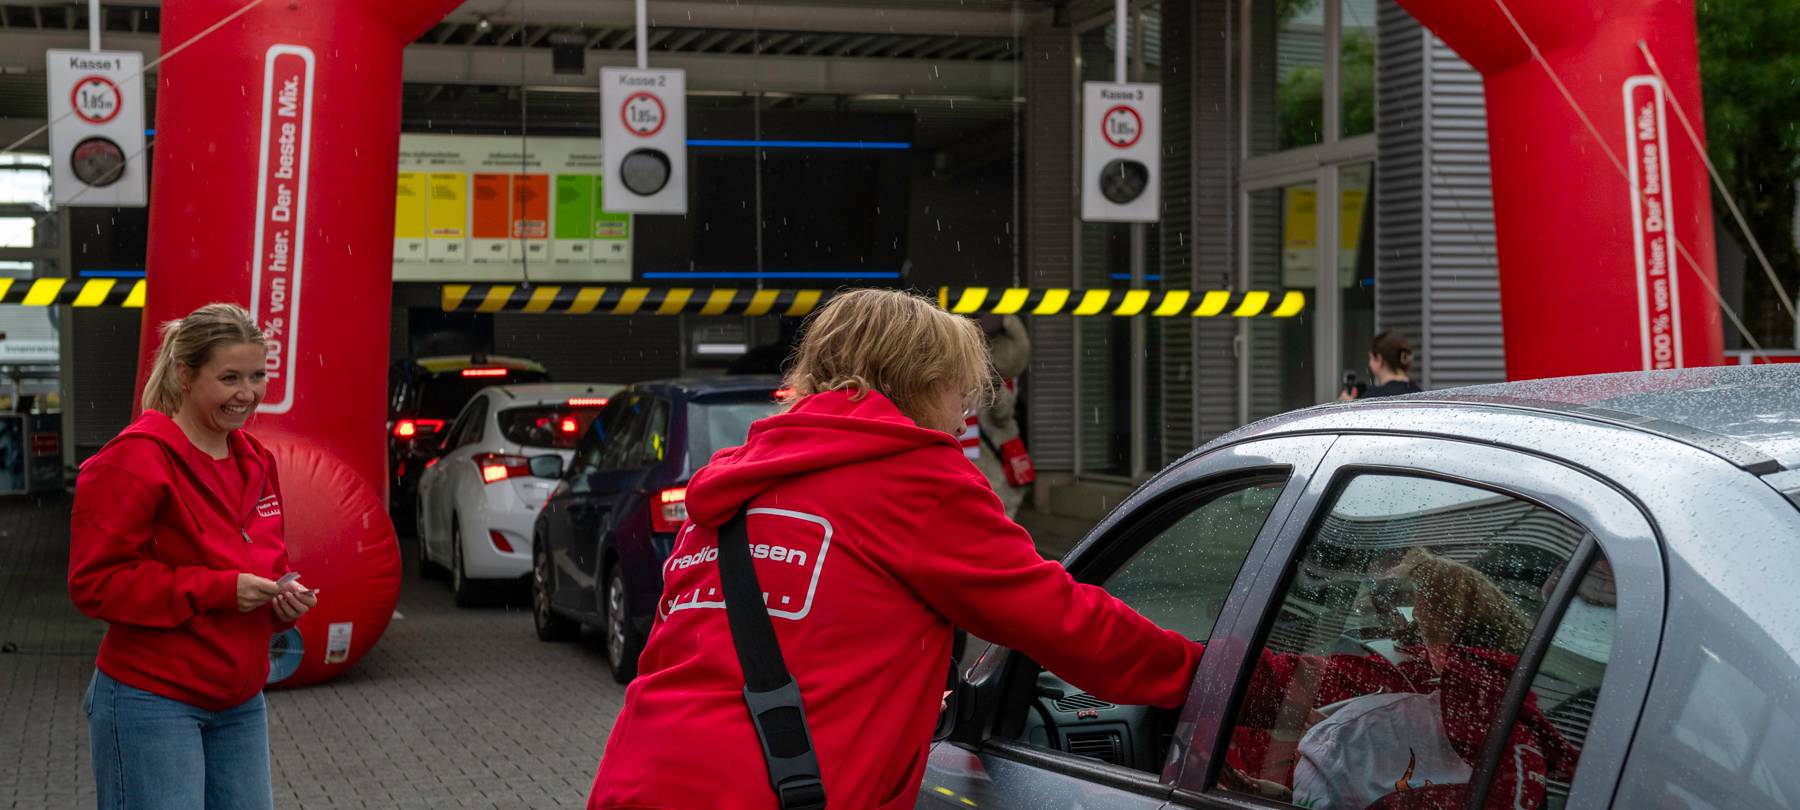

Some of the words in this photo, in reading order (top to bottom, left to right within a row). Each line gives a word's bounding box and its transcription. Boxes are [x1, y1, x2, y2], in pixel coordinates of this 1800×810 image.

[70, 56, 112, 70] Kasse
[115, 58, 121, 71] 1
[619, 75, 656, 87] Kasse
[658, 75, 667, 87] 2
[277, 74, 300, 118] Mix.
[1101, 88, 1134, 100] Kasse
[1136, 89, 1144, 101] 3
[1638, 101, 1656, 140] Mix.
[274, 122, 296, 180] beste
[1643, 142, 1660, 195] beste
[271, 183, 292, 223] Der
[1645, 197, 1664, 233] Der
[268, 229, 290, 273] hier.
[1648, 236, 1667, 276] hier.
[270, 276, 287, 314] von
[1653, 278, 1669, 313] von
[669, 546, 719, 572] radio
